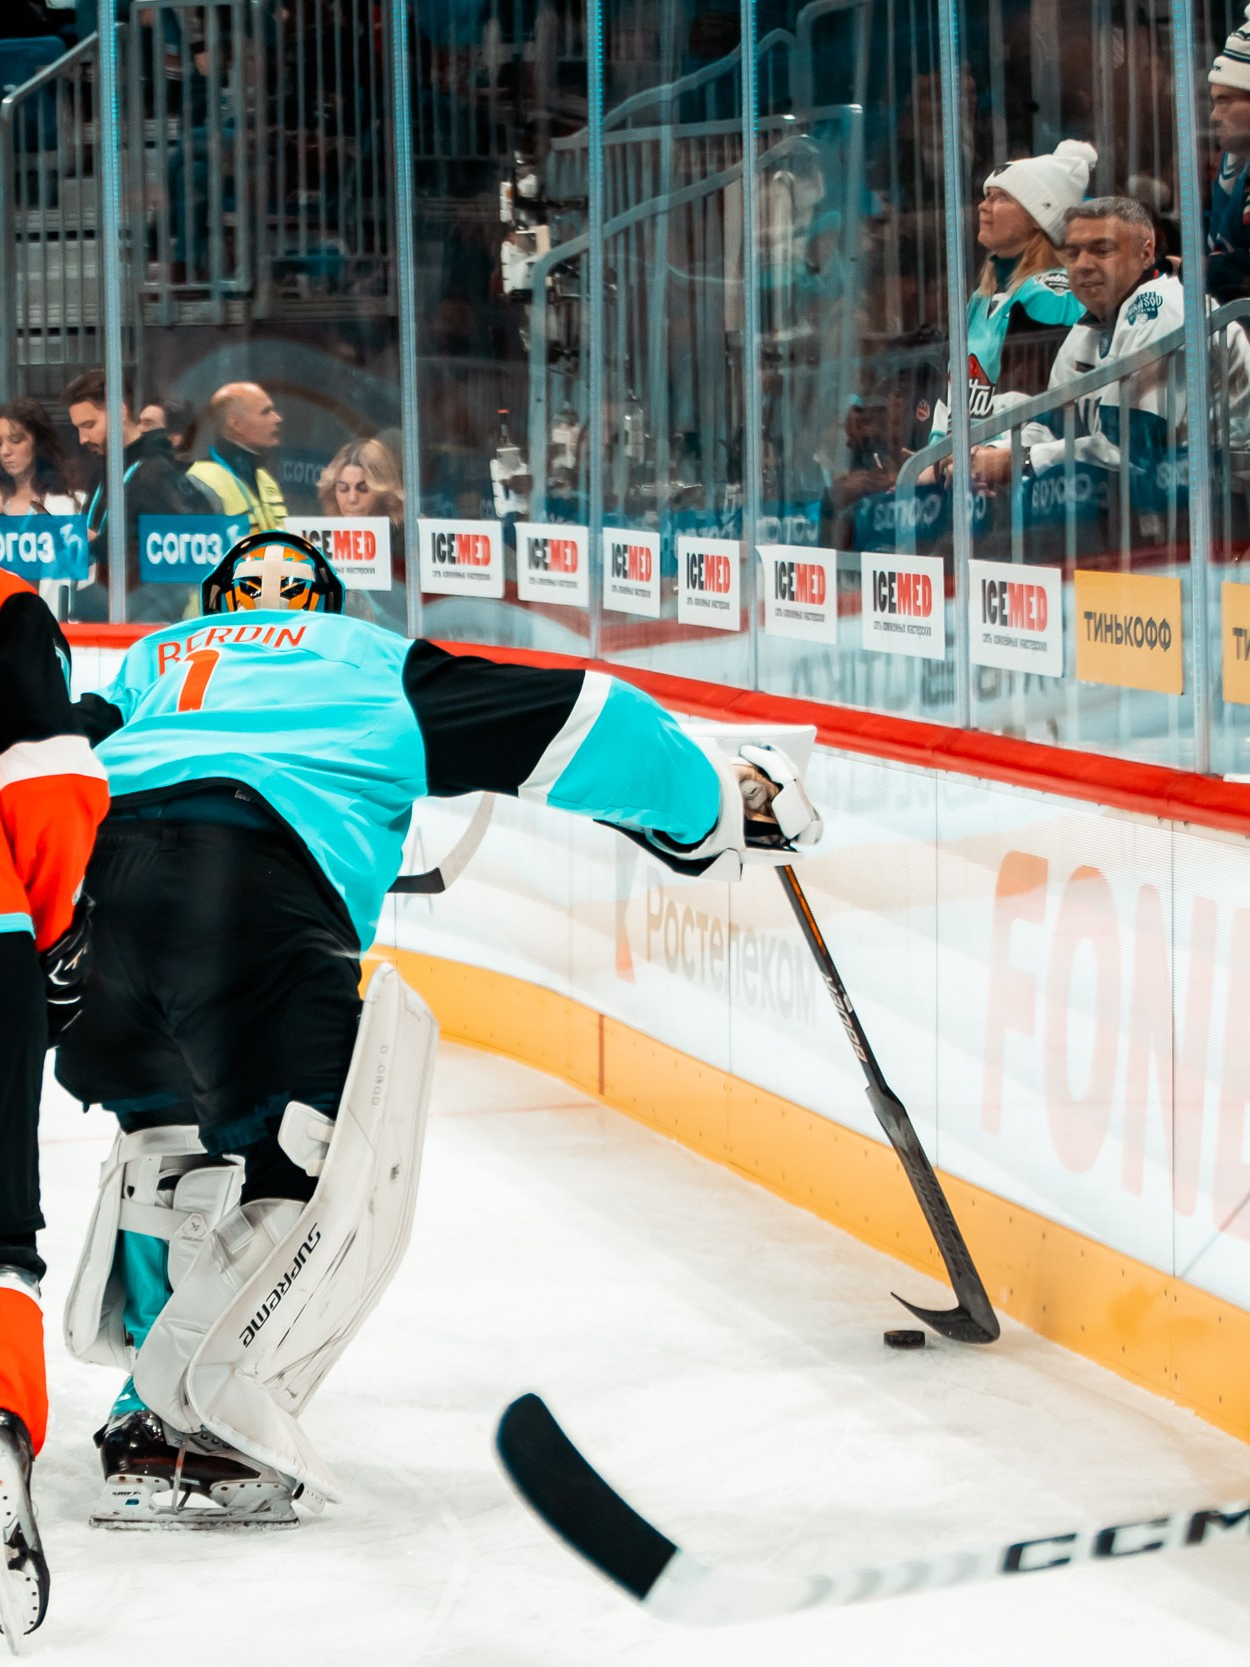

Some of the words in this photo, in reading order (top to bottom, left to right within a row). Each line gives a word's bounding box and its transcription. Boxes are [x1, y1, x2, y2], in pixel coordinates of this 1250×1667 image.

[146, 532, 222, 565] согаз
[430, 532, 491, 567] ICEMED
[528, 536, 578, 574] ICEMED
[611, 542, 652, 582] ICEMED
[686, 552, 731, 594] ICEMED
[774, 560, 826, 605] ICEMED
[872, 569, 933, 618] ICEMED
[981, 579, 1048, 632] ICEMED
[158, 626, 307, 676] BERDIN
[1083, 611, 1172, 652] ТИНЬКОФФ
[176, 648, 223, 713] 1
[646, 864, 816, 1030] Ростелеком
[1001, 1508, 1250, 1574] CCM
